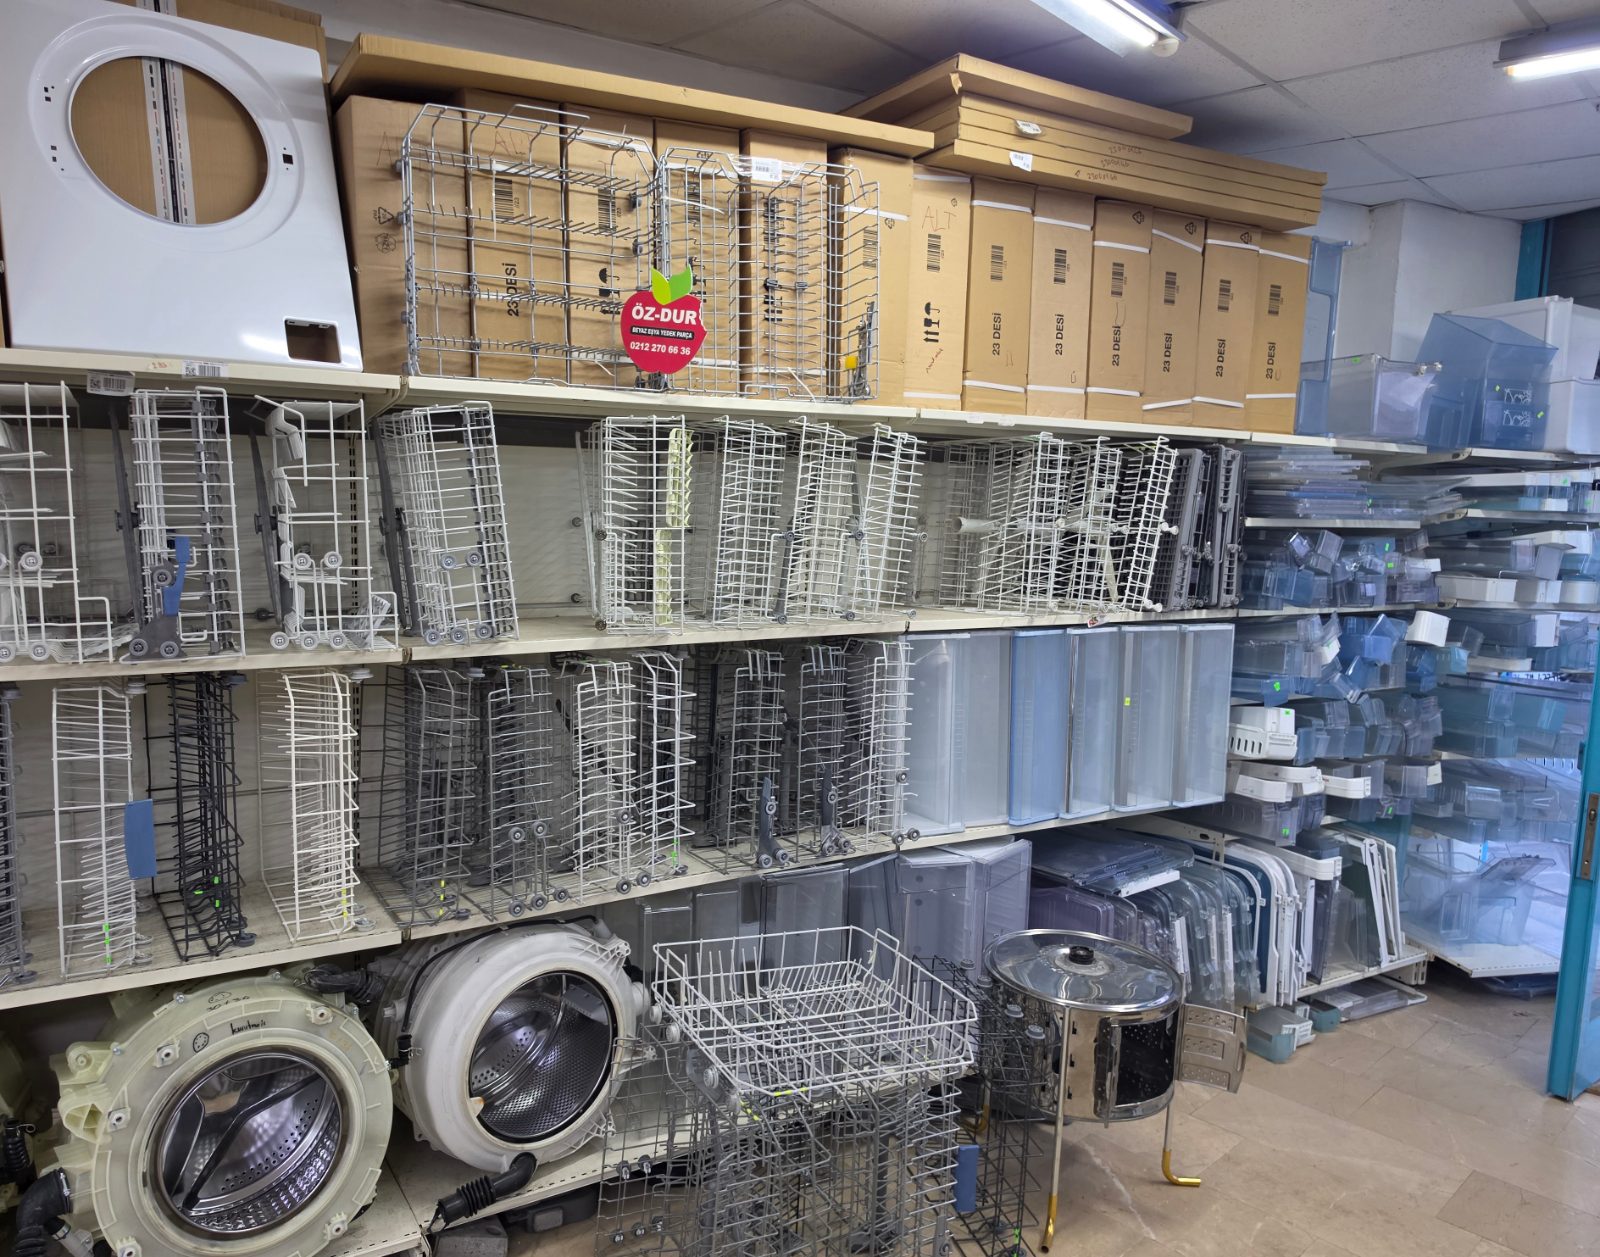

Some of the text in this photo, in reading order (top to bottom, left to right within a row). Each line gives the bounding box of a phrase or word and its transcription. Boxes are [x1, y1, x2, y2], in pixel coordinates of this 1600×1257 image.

[507, 300, 519, 317] 23
[631, 302, 697, 325] ÖZ-DUR
[992, 312, 1001, 356] 23 DESİ
[1055, 314, 1064, 356] 23 DESİ
[630, 341, 650, 351] 0212
[651, 343, 666, 353] 270
[680, 346, 691, 355] 36
[1112, 354, 1120, 367] 23
[1163, 360, 1171, 373] 23
[1216, 365, 1224, 377] 23
[1266, 367, 1274, 379] 23
